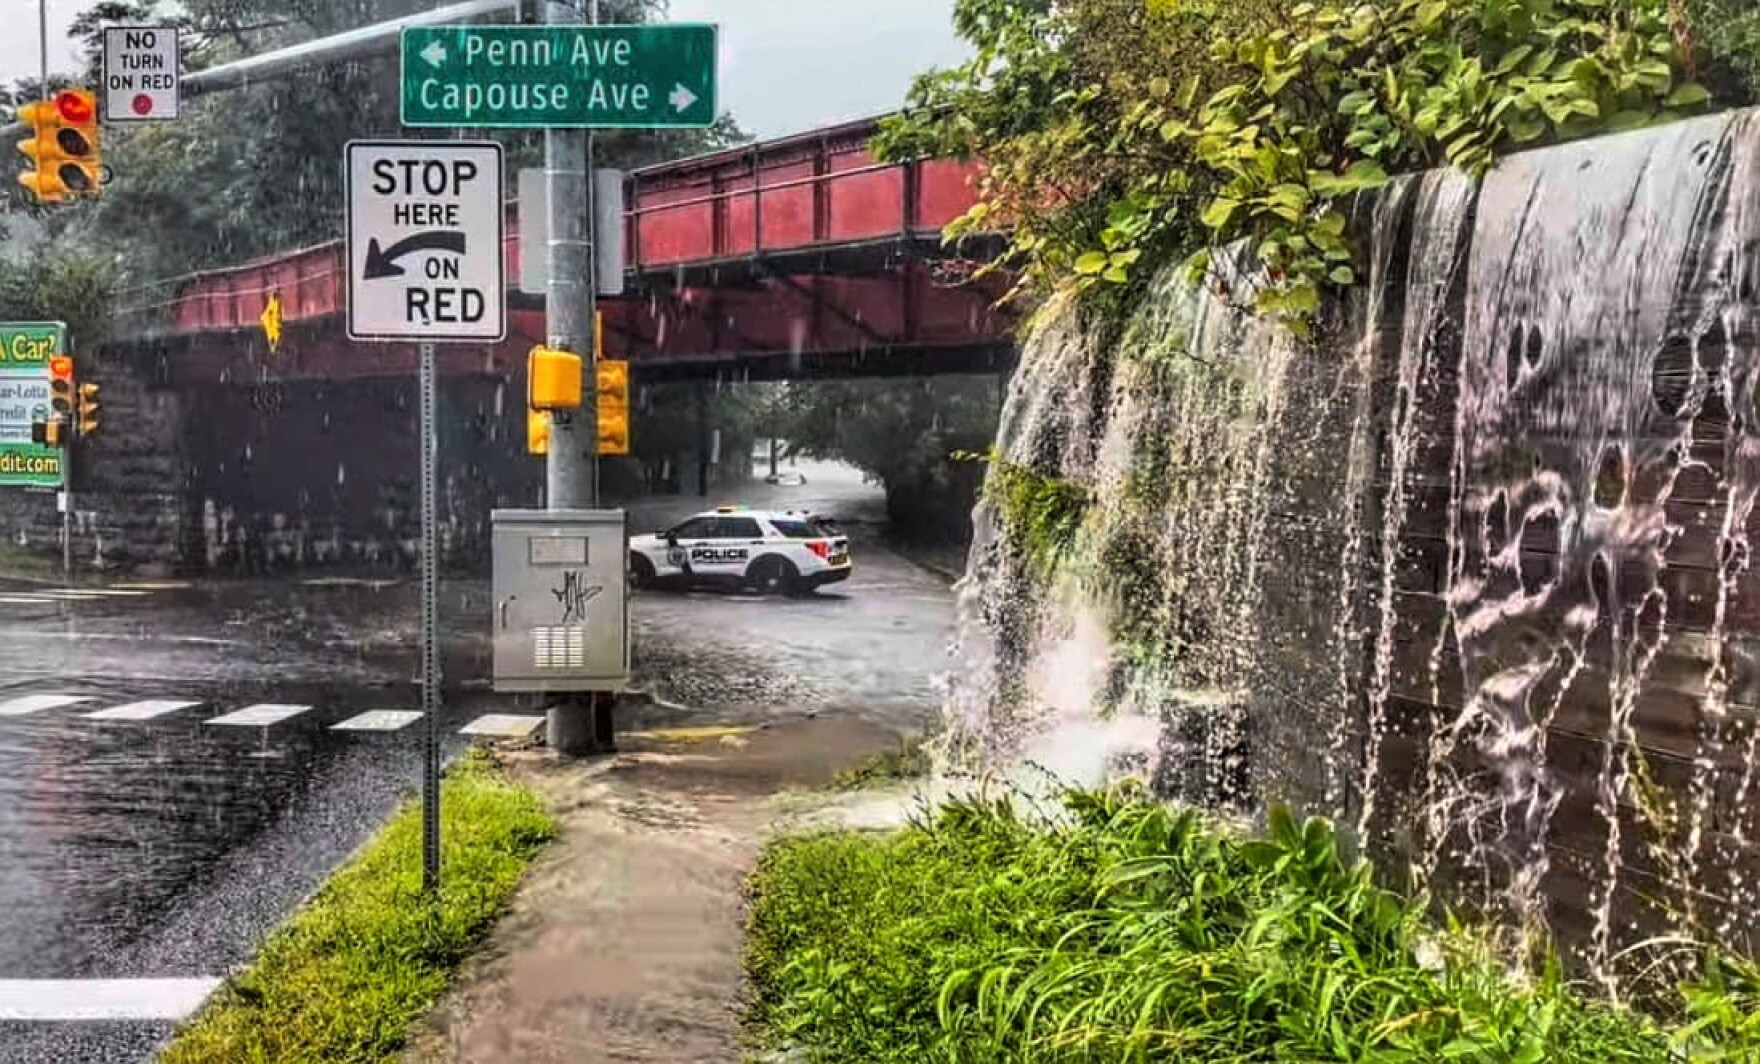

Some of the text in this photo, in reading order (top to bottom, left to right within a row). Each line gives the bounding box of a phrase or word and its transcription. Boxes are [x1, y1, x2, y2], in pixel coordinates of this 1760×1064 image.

[125, 31, 156, 49] NO
[465, 34, 632, 66] Penn Ave
[120, 53, 164, 70] TURN
[110, 74, 174, 90] ON RED
[420, 77, 650, 119] Capouse Ave
[372, 159, 478, 196] STOP
[393, 203, 460, 226] HERE
[425, 256, 459, 279] ON
[405, 286, 485, 323] RED
[12, 335, 56, 360] Car?
[691, 548, 749, 559] POLICE
